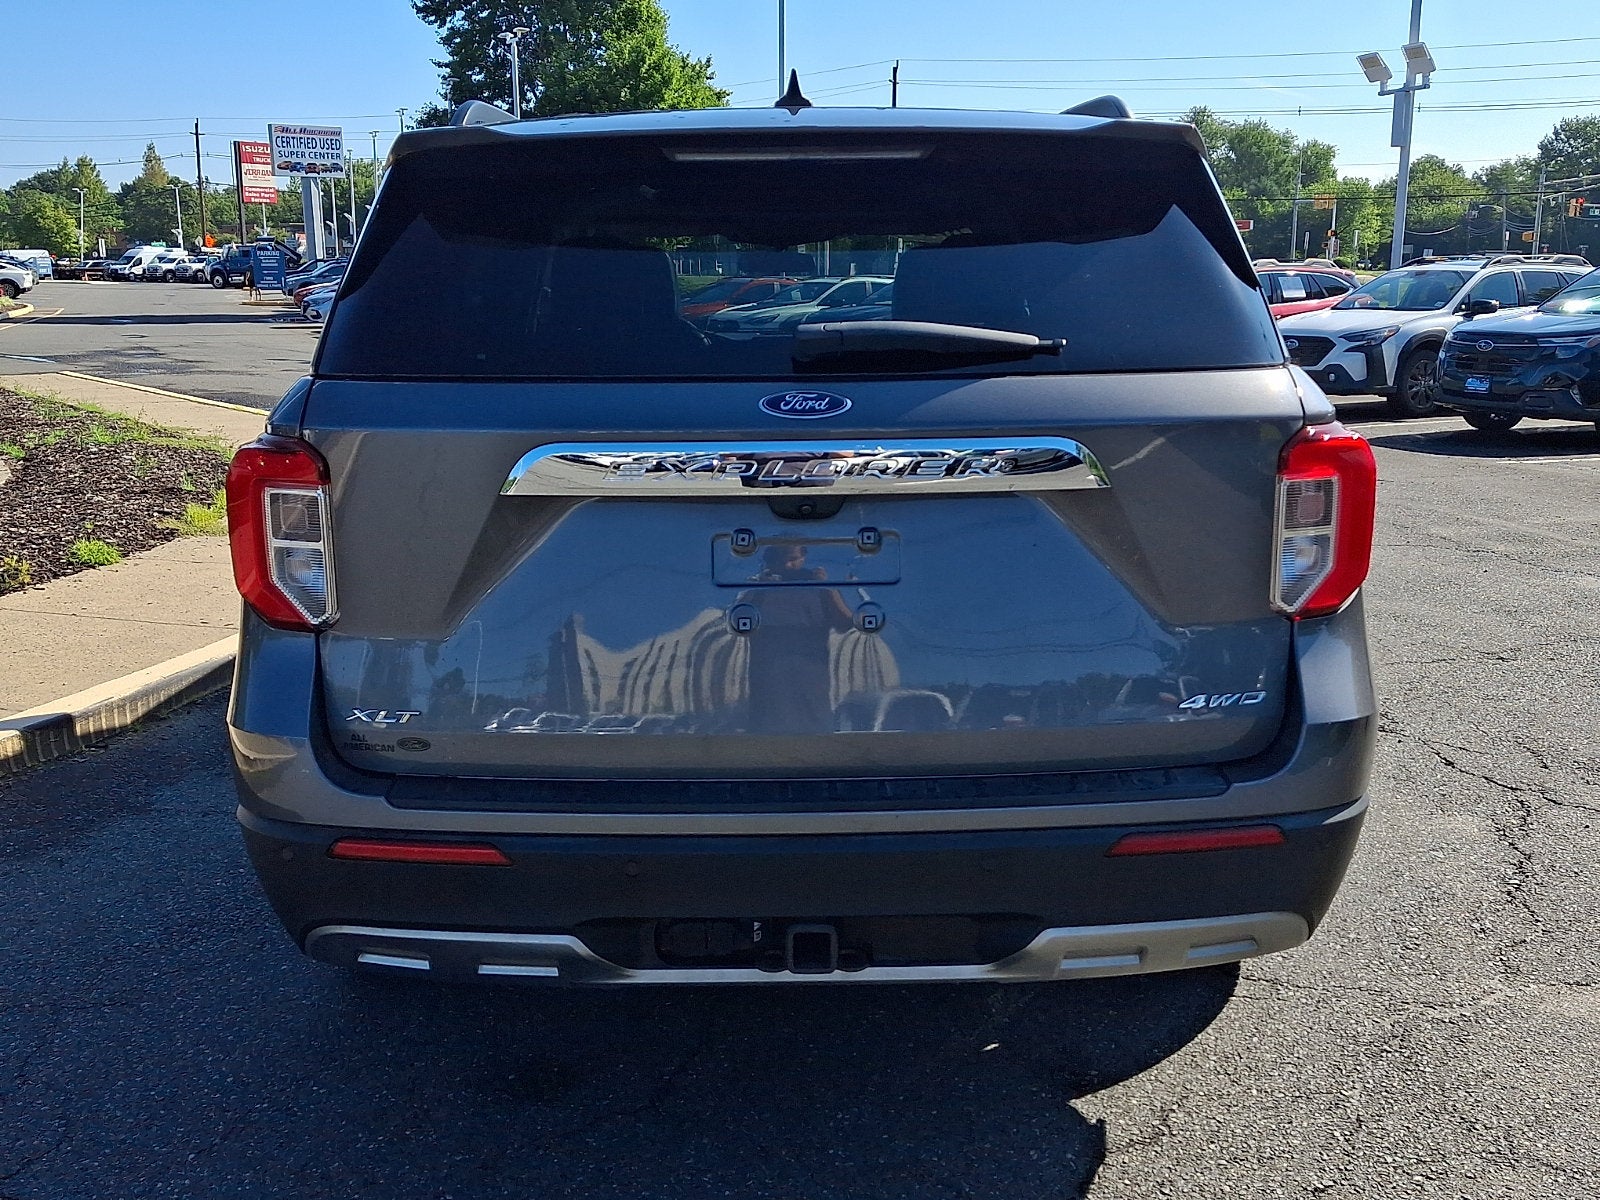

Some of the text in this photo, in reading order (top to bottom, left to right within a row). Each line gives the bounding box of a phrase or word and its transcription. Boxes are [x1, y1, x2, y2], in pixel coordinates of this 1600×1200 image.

[242, 144, 270, 153] ISUZU
[275, 136, 341, 151] CERTIFIED USED
[278, 150, 341, 160] SUPER CENTER
[780, 393, 829, 411] Ford
[603, 458, 1004, 481] EXPLORER
[1178, 691, 1267, 709] 4WD
[345, 708, 421, 723] XLT
[351, 734, 368, 742] ALL
[344, 742, 395, 752] AMERICAN
